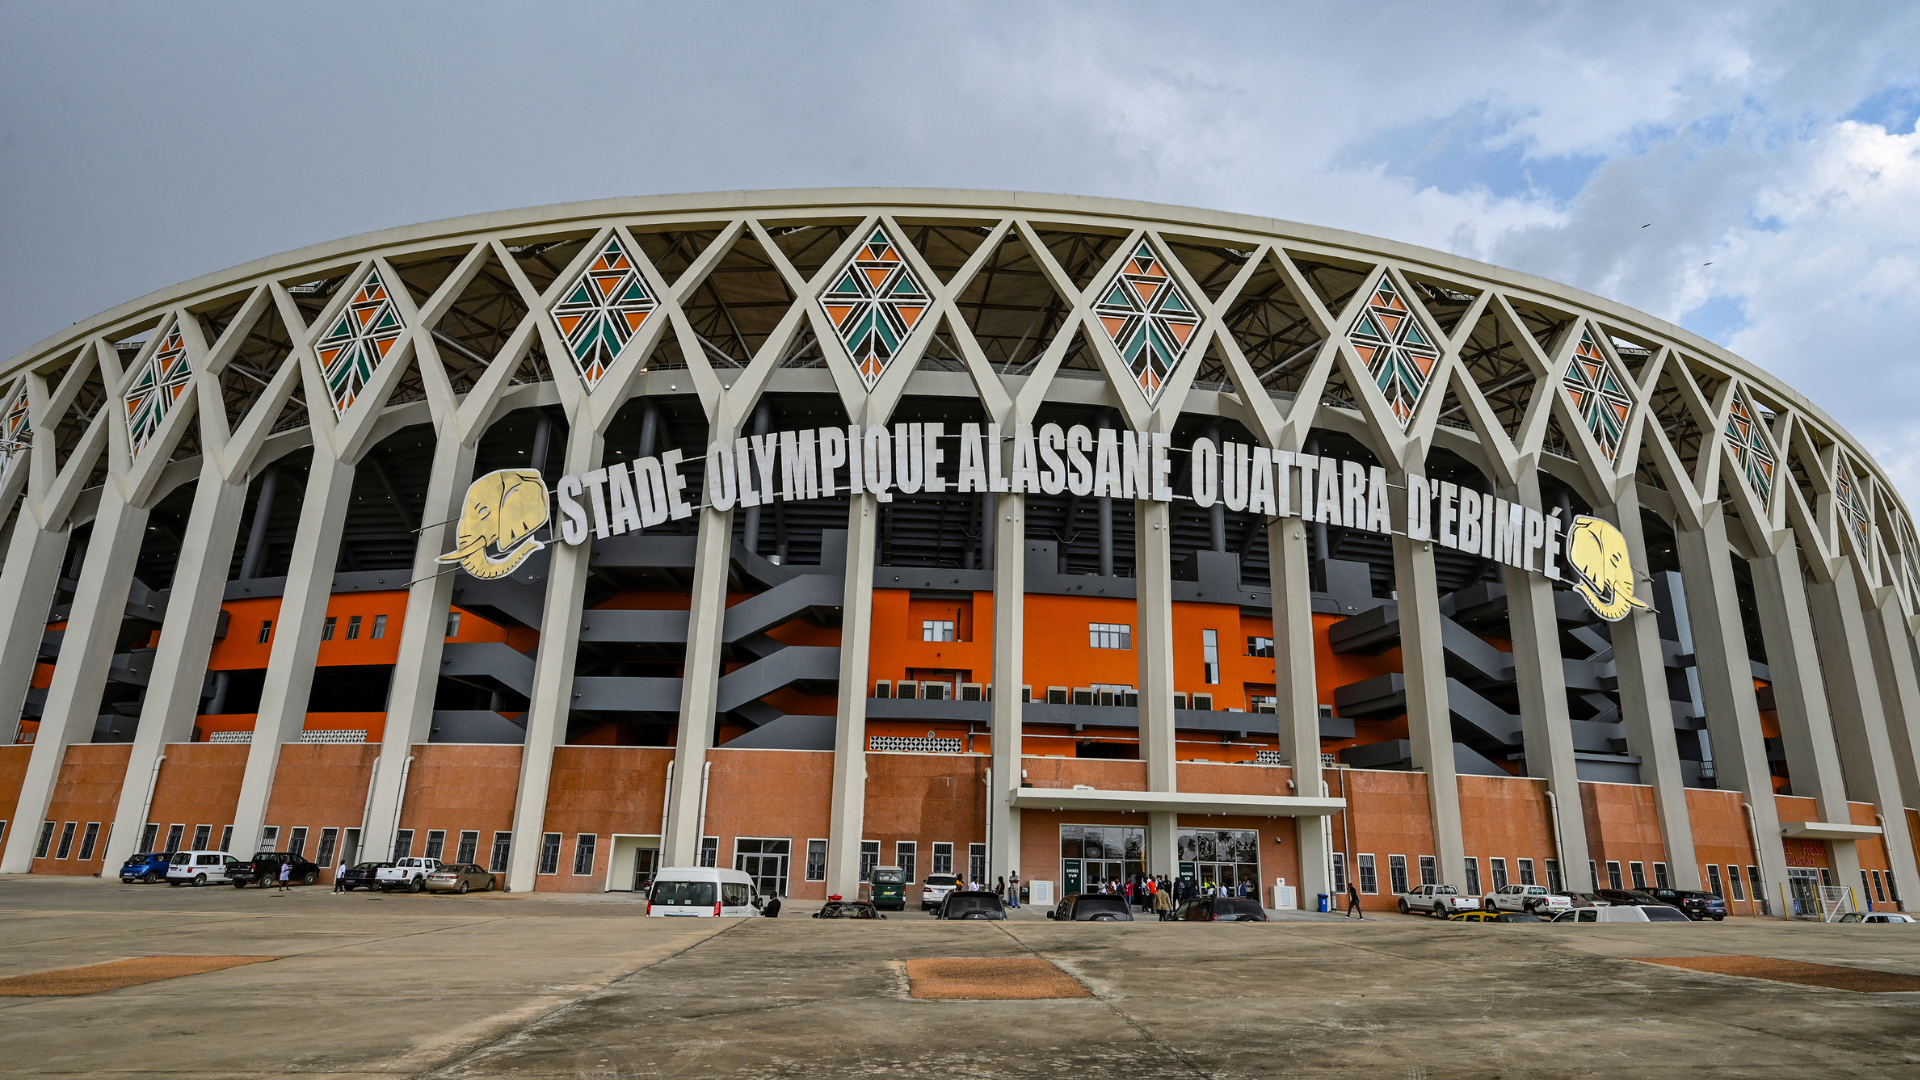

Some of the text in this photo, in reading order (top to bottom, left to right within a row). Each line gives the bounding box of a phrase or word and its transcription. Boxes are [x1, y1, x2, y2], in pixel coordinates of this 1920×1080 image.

[557, 422, 1562, 581] STADE OLYMPIQUE ALASSANE OUATTARA D'EBIMPÉ
[1801, 841, 1826, 856] PRESSE
